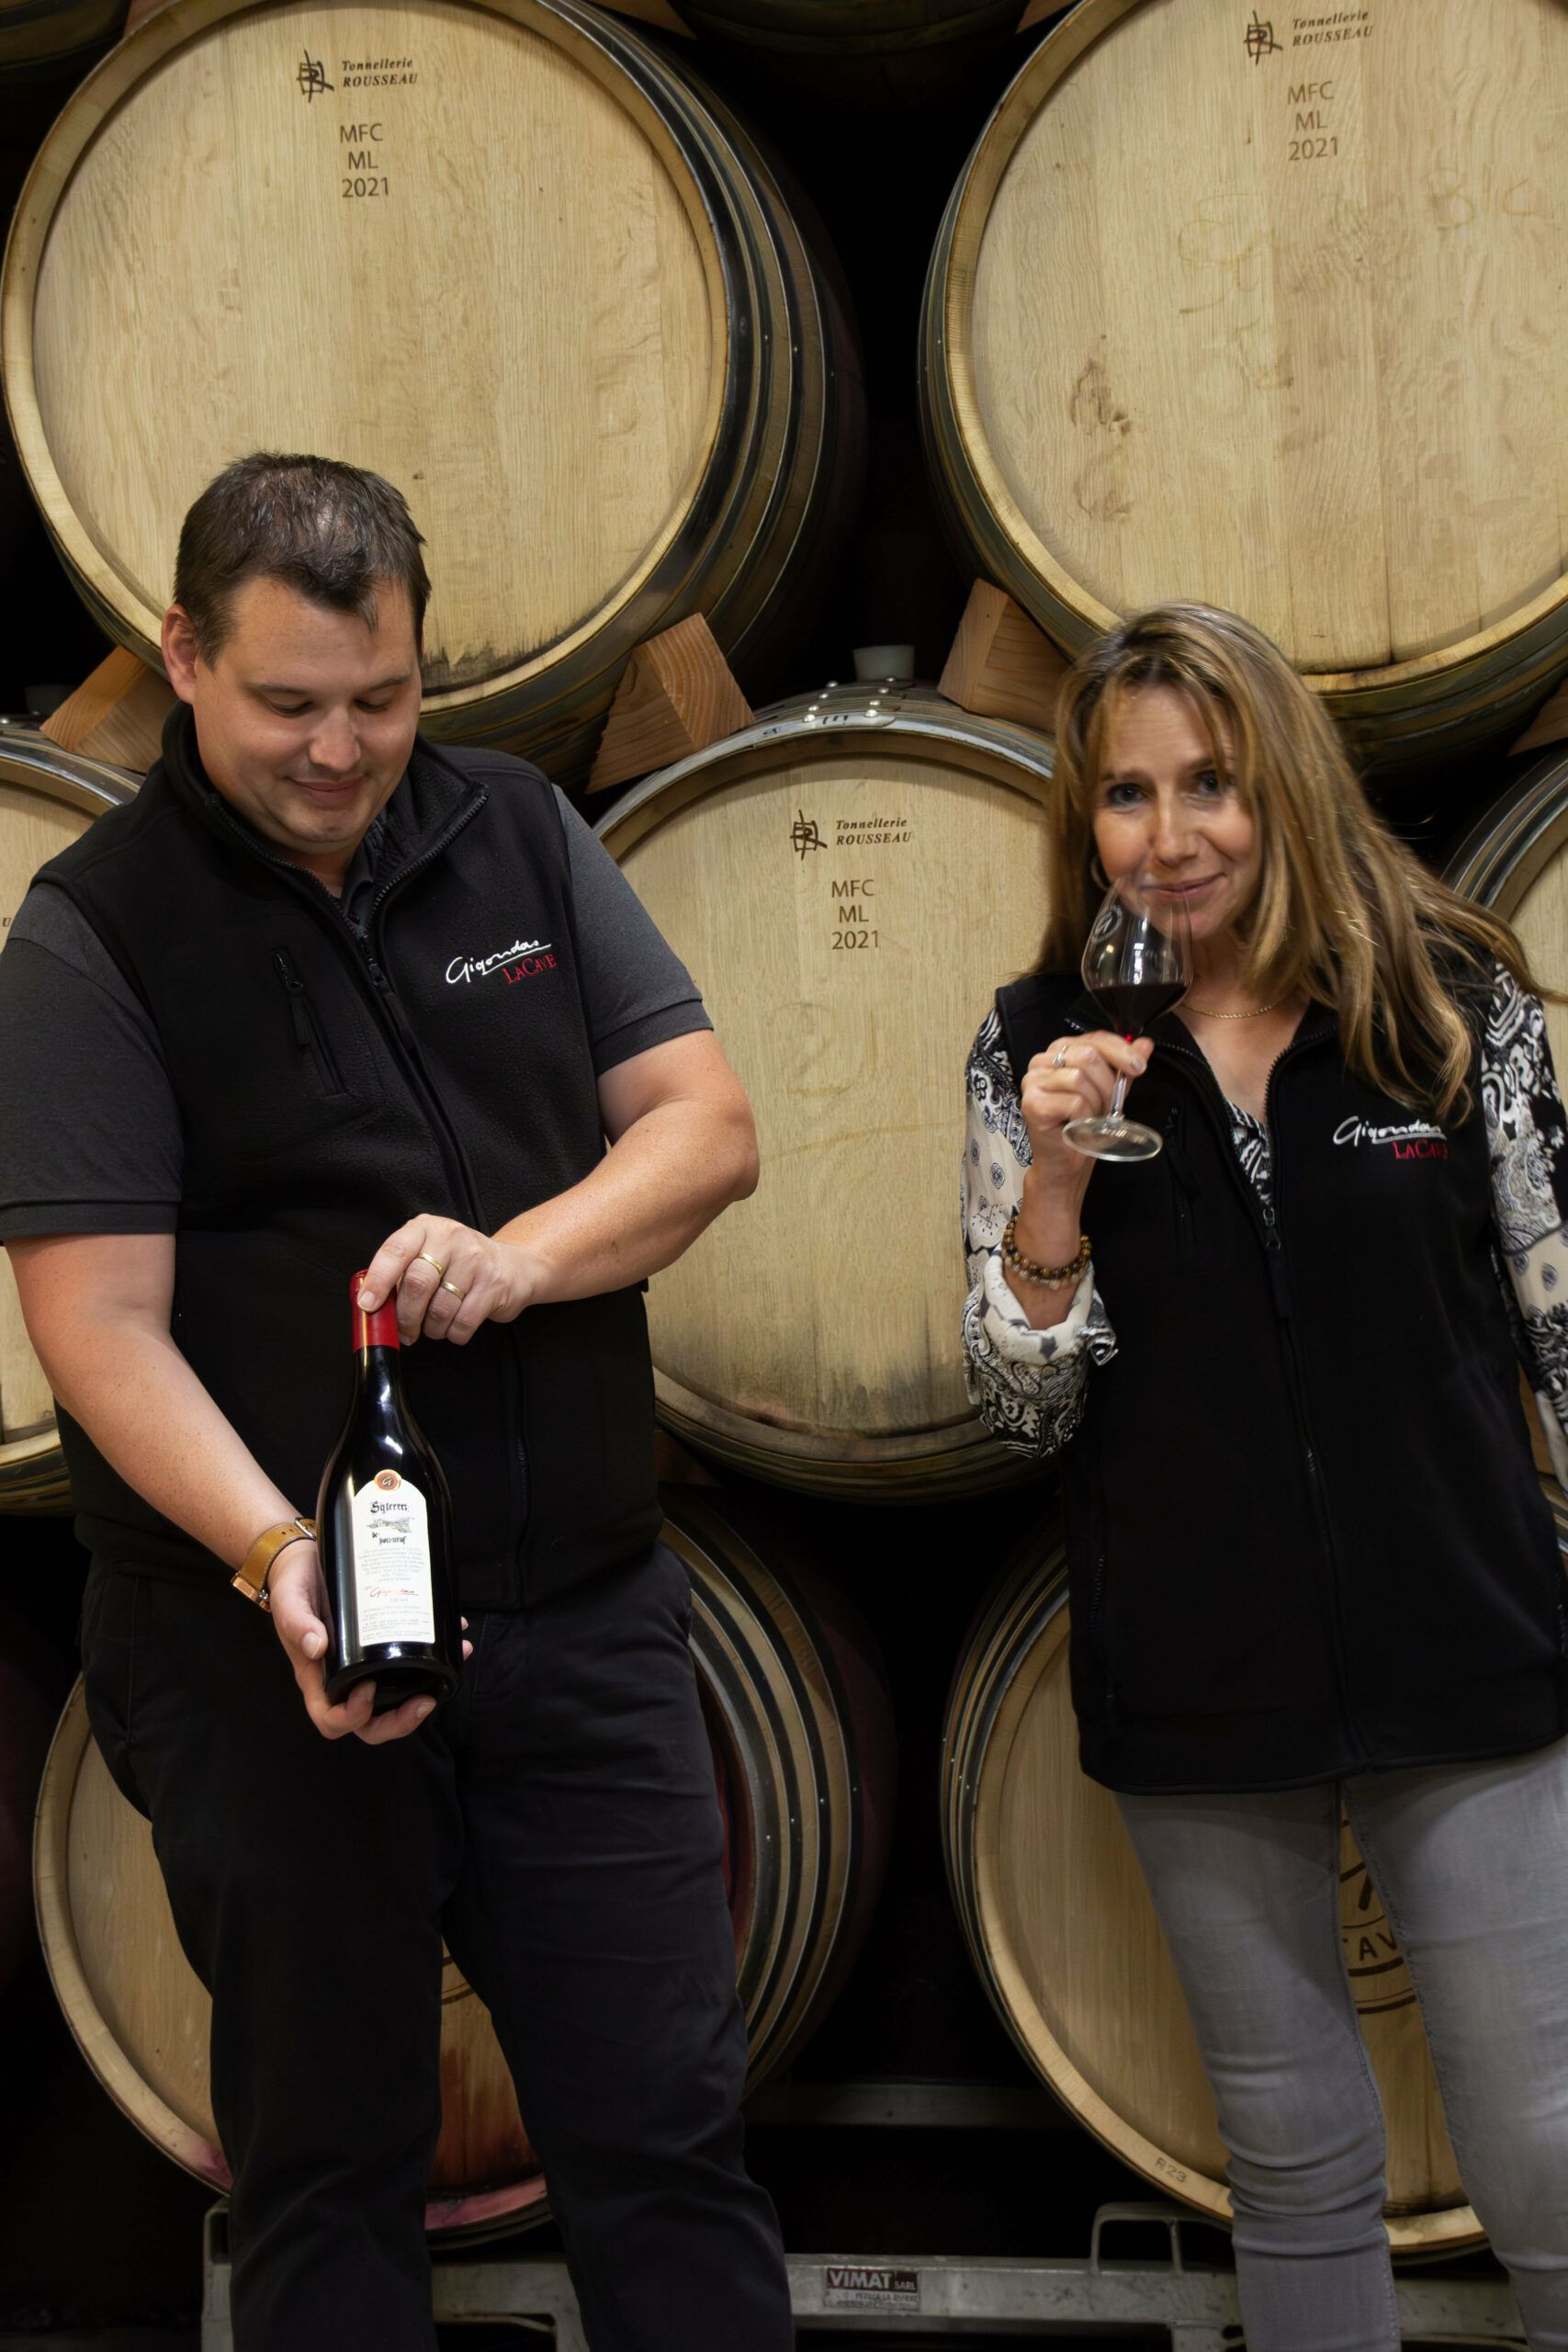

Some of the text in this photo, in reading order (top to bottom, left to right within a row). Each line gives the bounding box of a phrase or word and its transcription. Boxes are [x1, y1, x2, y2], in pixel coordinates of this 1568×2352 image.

[1292, 10, 1369, 30] Tonnellerie
[1292, 25, 1374, 47] ROUSSEAU
[342, 57, 413, 72] Tonnellerie
[343, 73, 418, 88] ROUSSEAU
[1287, 80, 1335, 106] MFC
[1295, 109, 1328, 132] ML
[339, 122, 384, 143] MFC
[1288, 136, 1339, 162] 2021
[347, 150, 379, 170] ML
[341, 176, 389, 198] 2021
[835, 817, 908, 831] Tonnellerie
[835, 831, 912, 846] ROUSSEAU
[830, 878, 875, 899] MFC
[838, 904, 870, 923] ML
[830, 930, 879, 950] 2021
[445, 939, 551, 985] Gigondas
[829, 2269, 893, 2289] VIMAT
